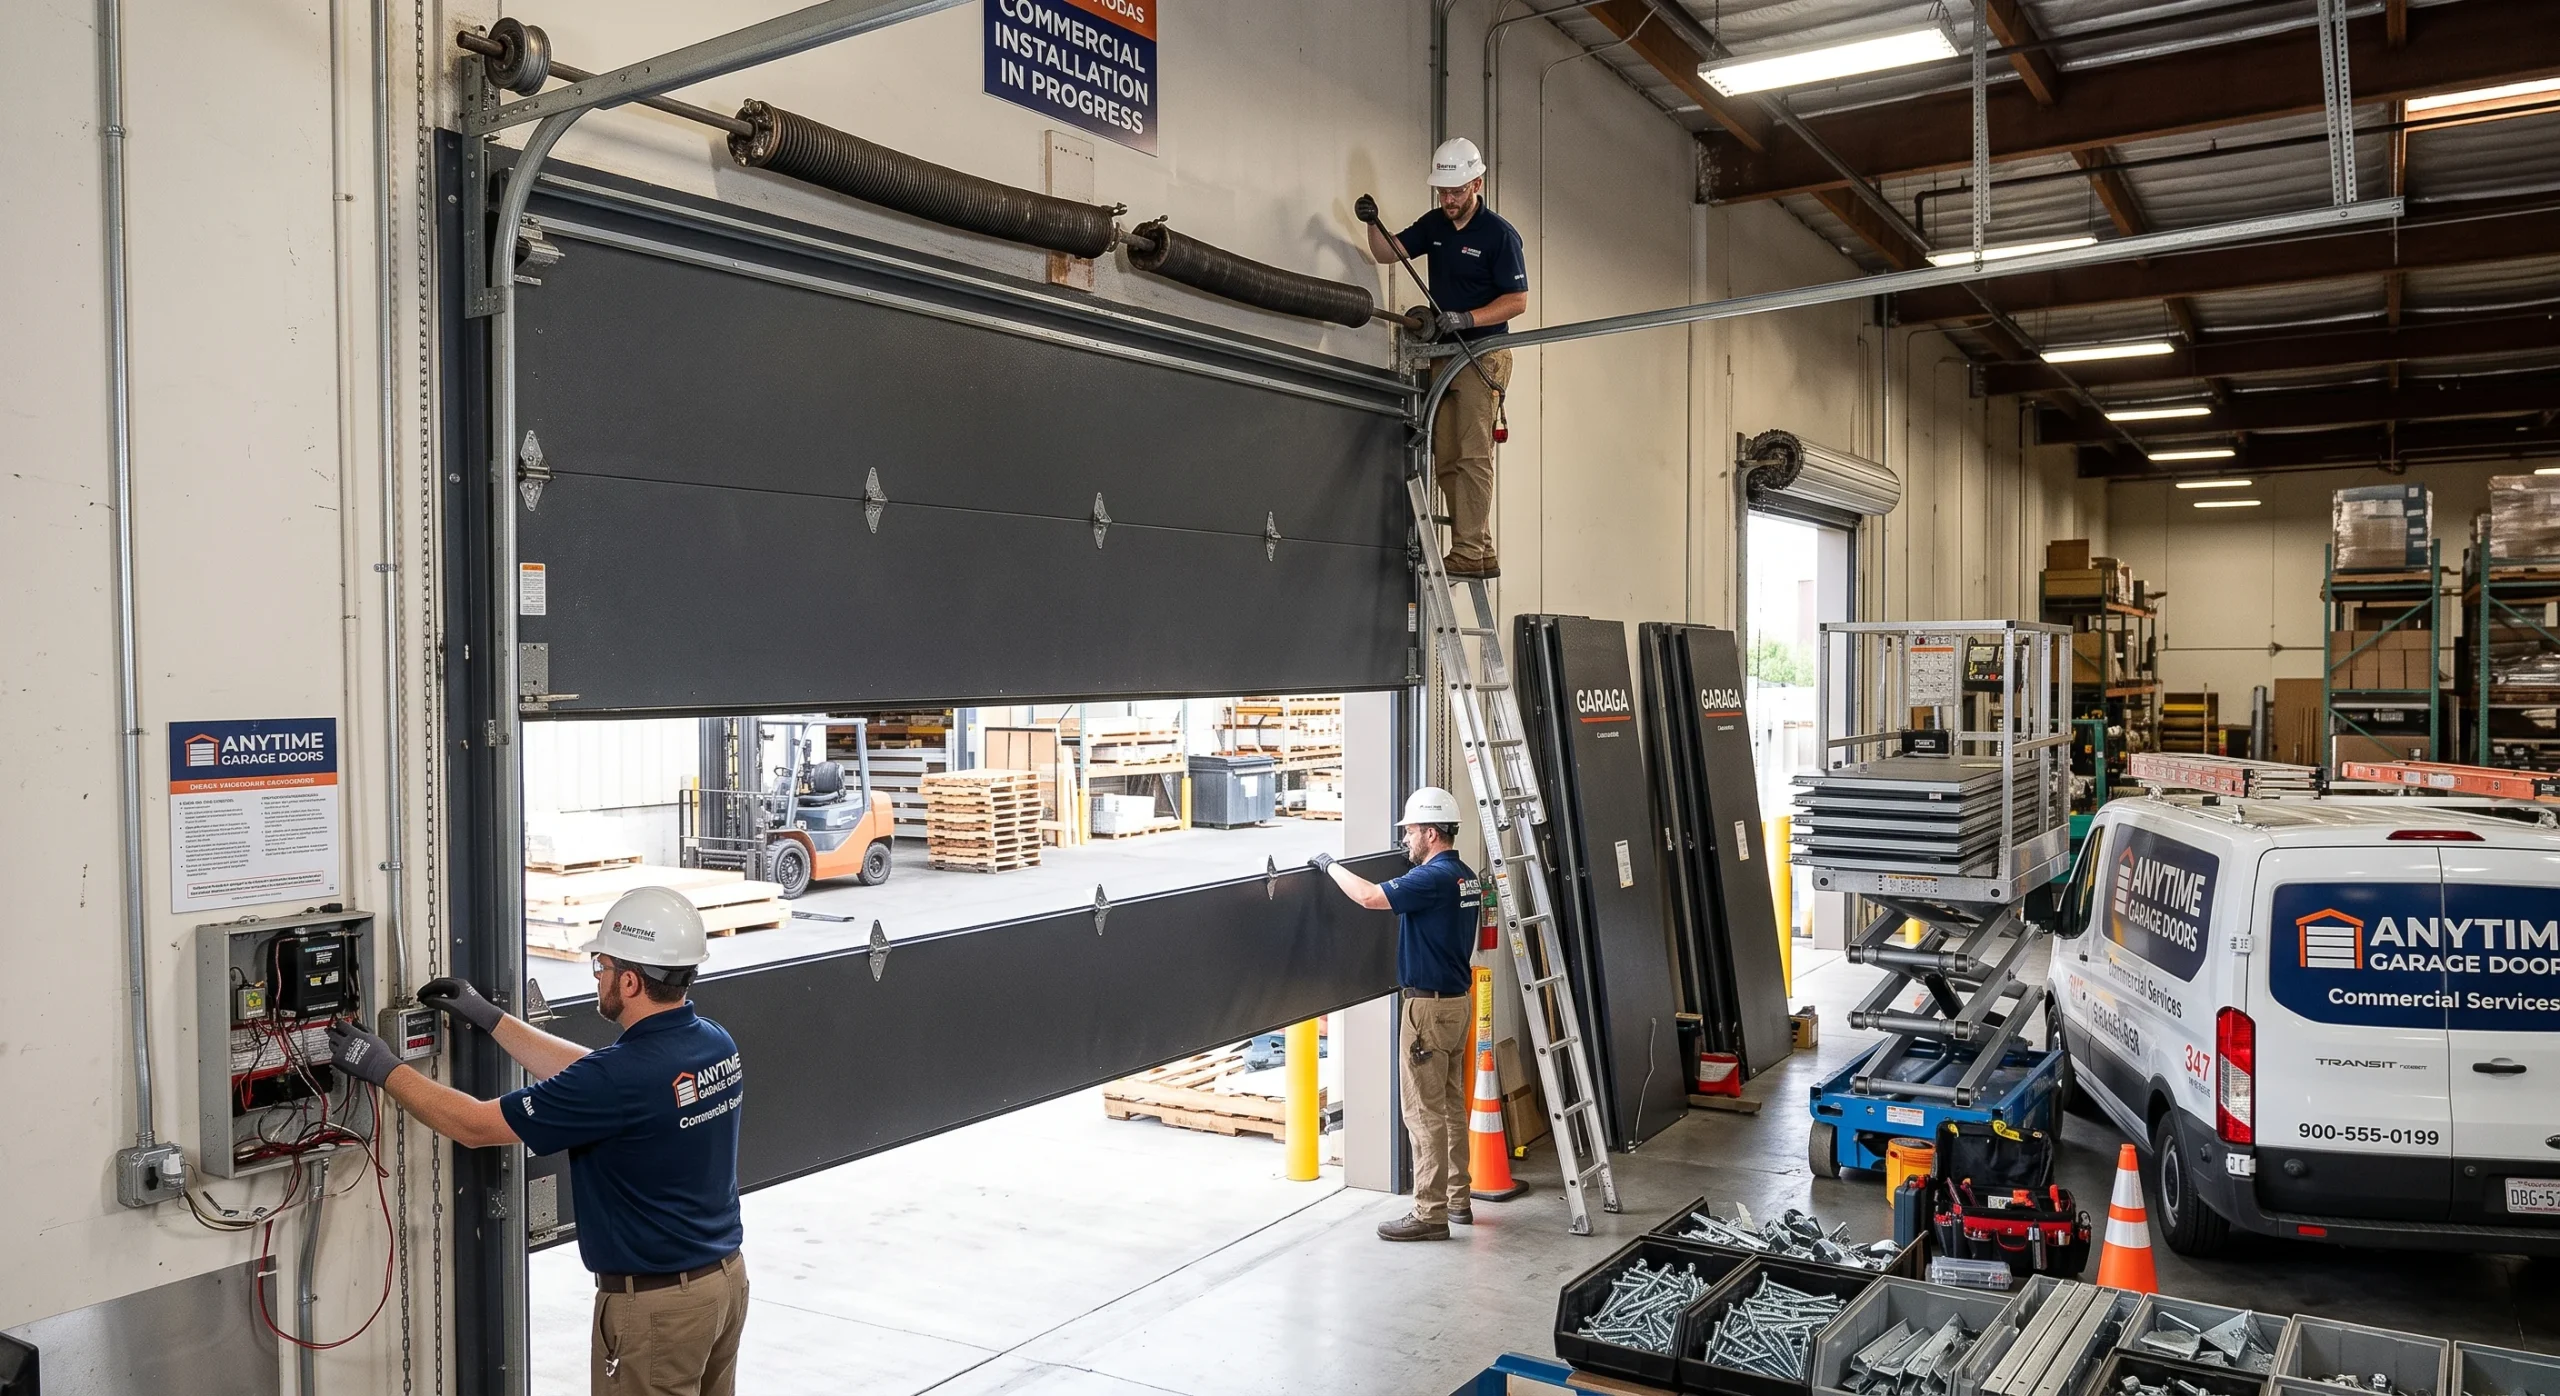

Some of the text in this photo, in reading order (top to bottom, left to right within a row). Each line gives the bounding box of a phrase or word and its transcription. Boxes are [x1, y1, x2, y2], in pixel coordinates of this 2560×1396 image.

[1000, 0, 1146, 74] COMMERCIAL
[995, 21, 1149, 106] INSTALLATION
[1001, 57, 1144, 135] IN PROGRESS
[1576, 689, 1630, 713] GARAGA
[1701, 688, 1742, 710] GARAGA
[221, 732, 325, 753] ANYTIME
[221, 751, 324, 766] GARAGE DOORS
[2131, 856, 2206, 918] ANYTIME
[2128, 899, 2198, 952] GARAGE DOORS
[2369, 953, 2481, 974] GARAGE
[2148, 979, 2182, 1019] Services
[2328, 987, 2560, 1012] Commercial Services
[697, 1052, 741, 1089] ANYTIME
[2185, 1043, 2211, 1082] 347
[2315, 1057, 2398, 1069] TRANSIT
[2298, 1122, 2440, 1146] 900-555-0199
